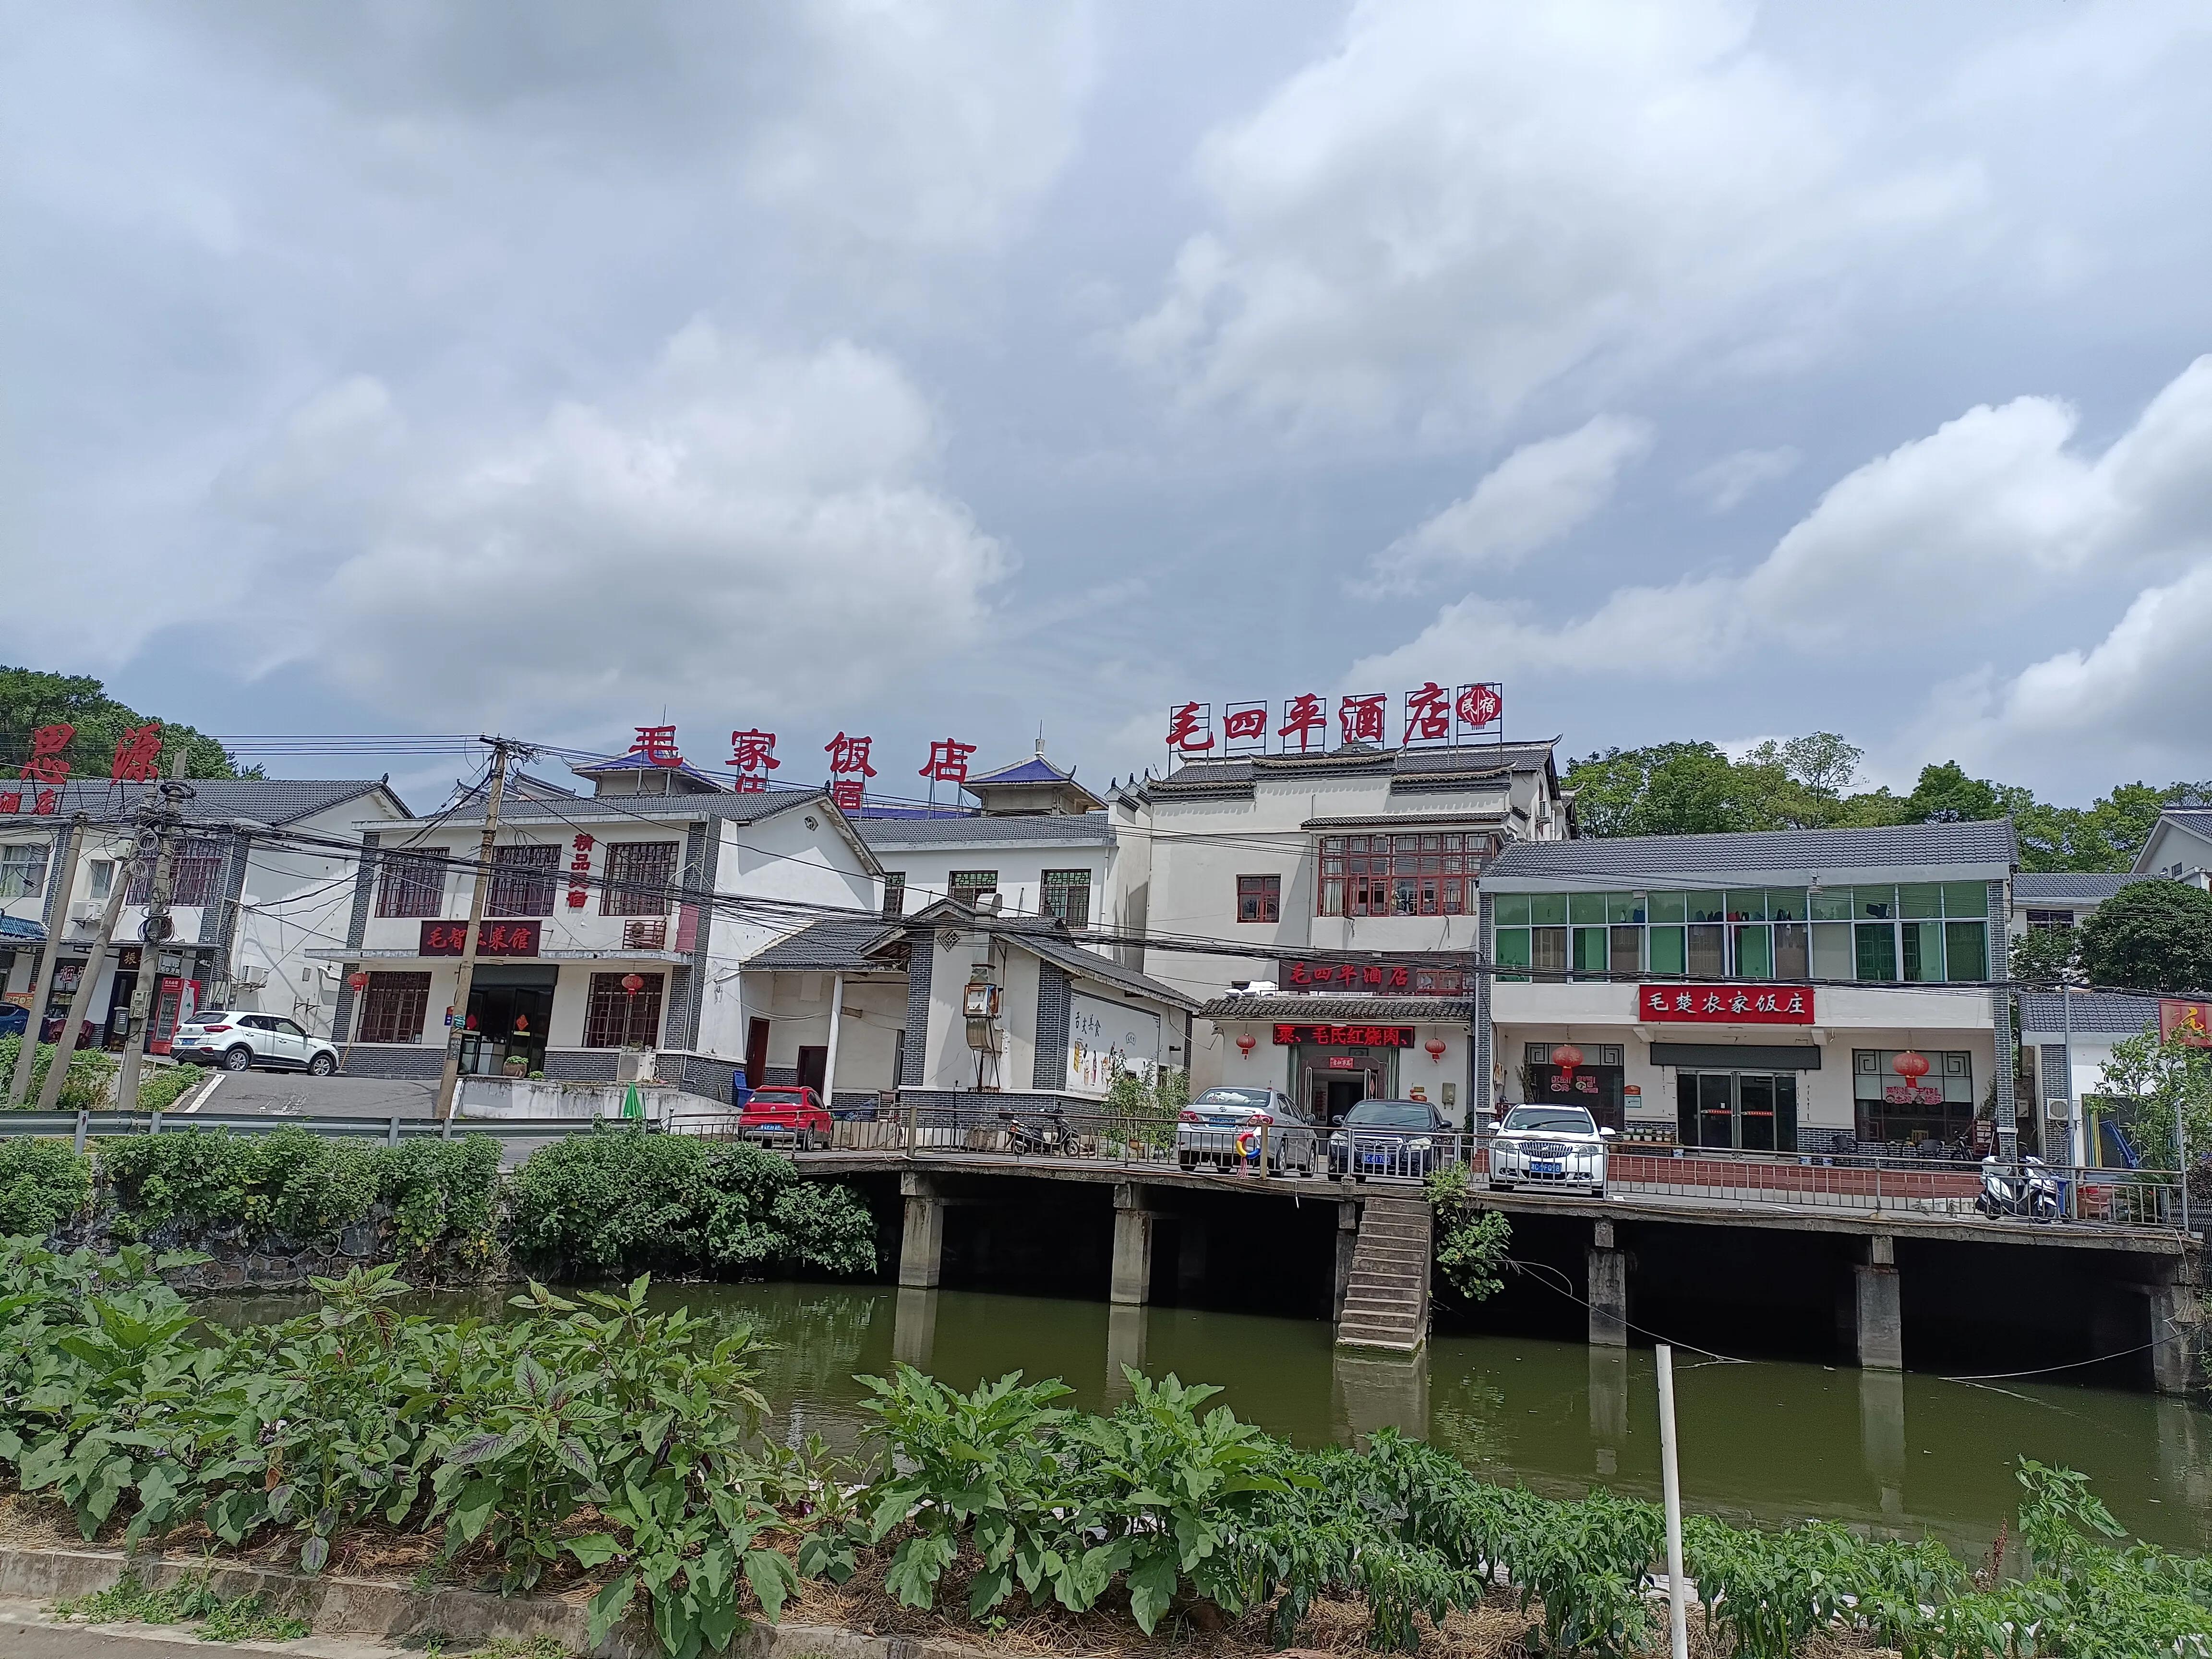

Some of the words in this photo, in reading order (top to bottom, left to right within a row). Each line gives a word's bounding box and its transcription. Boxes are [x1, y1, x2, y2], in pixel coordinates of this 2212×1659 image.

[1166, 682, 1451, 753] 毛四平酒店
[1462, 697, 1495, 714] 民宿
[20, 723, 162, 785] 思源
[628, 725, 977, 783] 毛家饭店
[427, 926, 531, 951] 毛智菜馆
[1290, 962, 1408, 987] 毛四平酒店
[1647, 991, 1805, 1014] 毛楚农家饭庄
[1075, 1011, 1101, 1037] 舌尖美食
